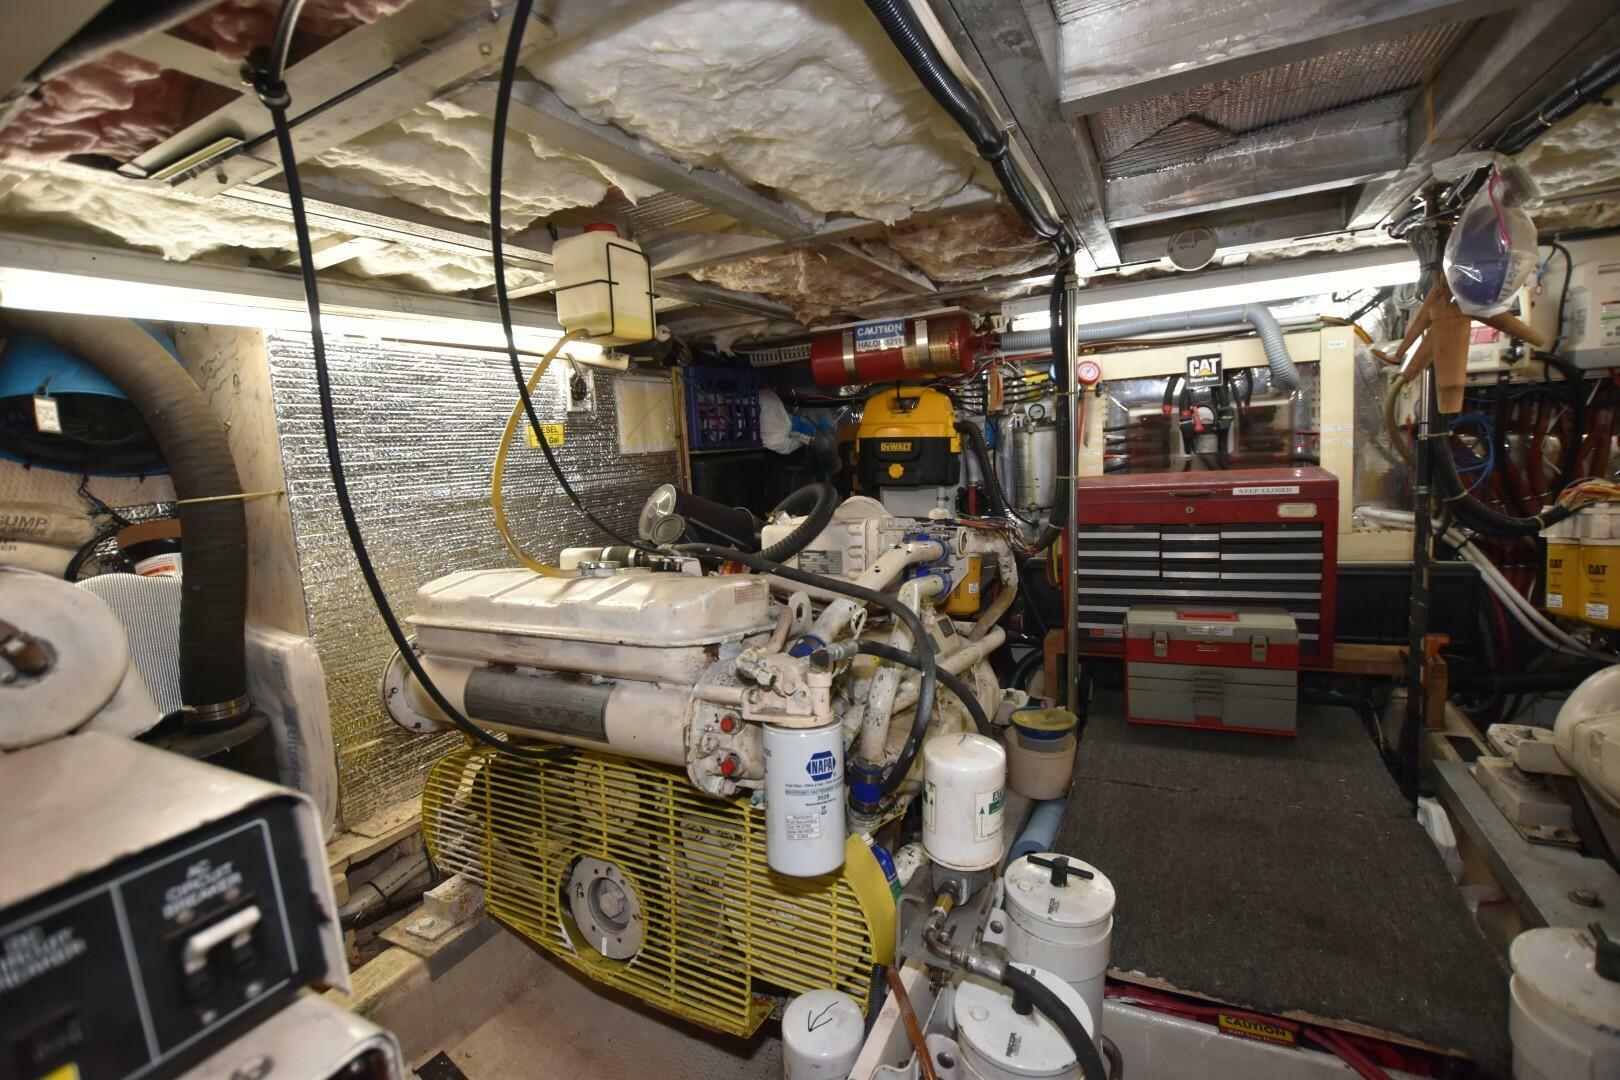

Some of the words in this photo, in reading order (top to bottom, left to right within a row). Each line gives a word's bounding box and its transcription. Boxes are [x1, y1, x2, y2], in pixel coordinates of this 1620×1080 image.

[857, 323, 903, 336] CAUTION
[858, 339, 882, 350] HALO
[1189, 358, 1221, 377] CAT
[1588, 564, 1609, 575] CAT
[811, 757, 833, 774] NAPA
[1224, 1016, 1287, 1037] CAUTION
